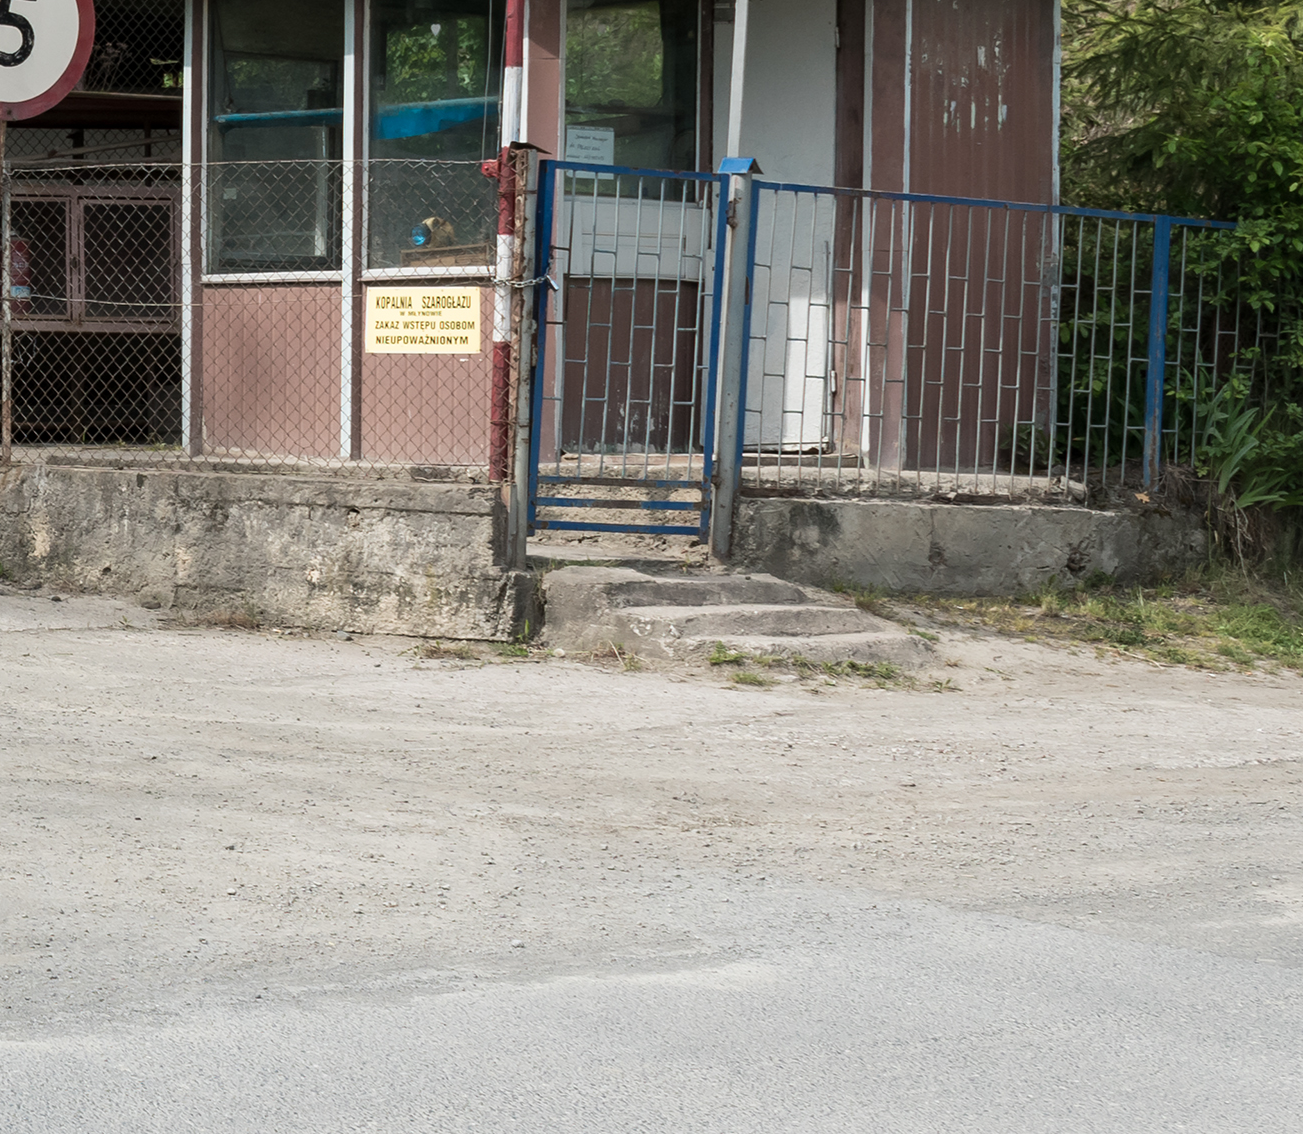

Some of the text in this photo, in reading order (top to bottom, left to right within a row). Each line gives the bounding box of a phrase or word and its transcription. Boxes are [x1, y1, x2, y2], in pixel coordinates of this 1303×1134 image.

[375, 296, 472, 309] KOPALNIA SZAROGŁAZU
[375, 321, 400, 329] ZAKAZ
[439, 321, 475, 330] OSOBOM
[375, 335, 469, 345] NIEUPOWAŻNIONYM
